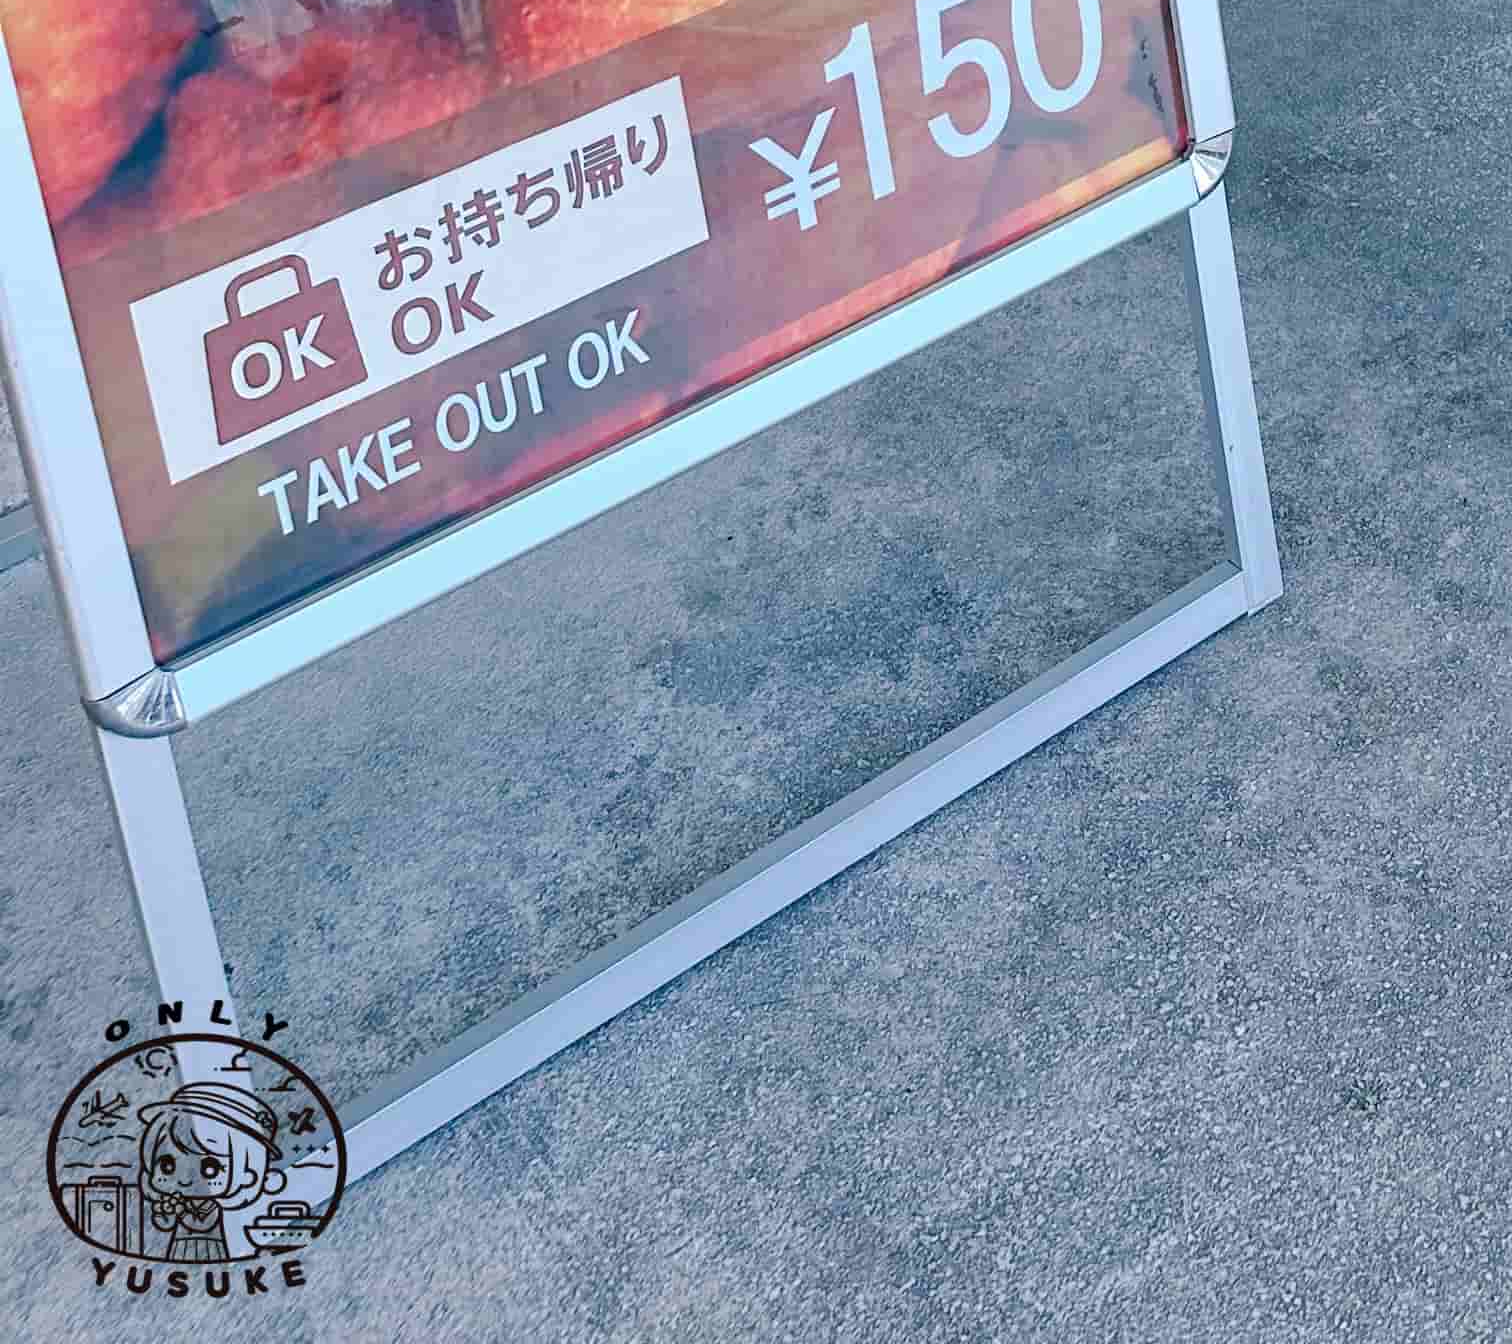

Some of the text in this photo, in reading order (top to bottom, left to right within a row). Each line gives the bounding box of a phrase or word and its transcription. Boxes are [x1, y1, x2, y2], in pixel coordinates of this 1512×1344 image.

[374, 114, 669, 291] お持ち帰り
[231, 313, 336, 400] OK
[391, 269, 496, 356] OK
[256, 306, 652, 537] TAKE OUT OK
